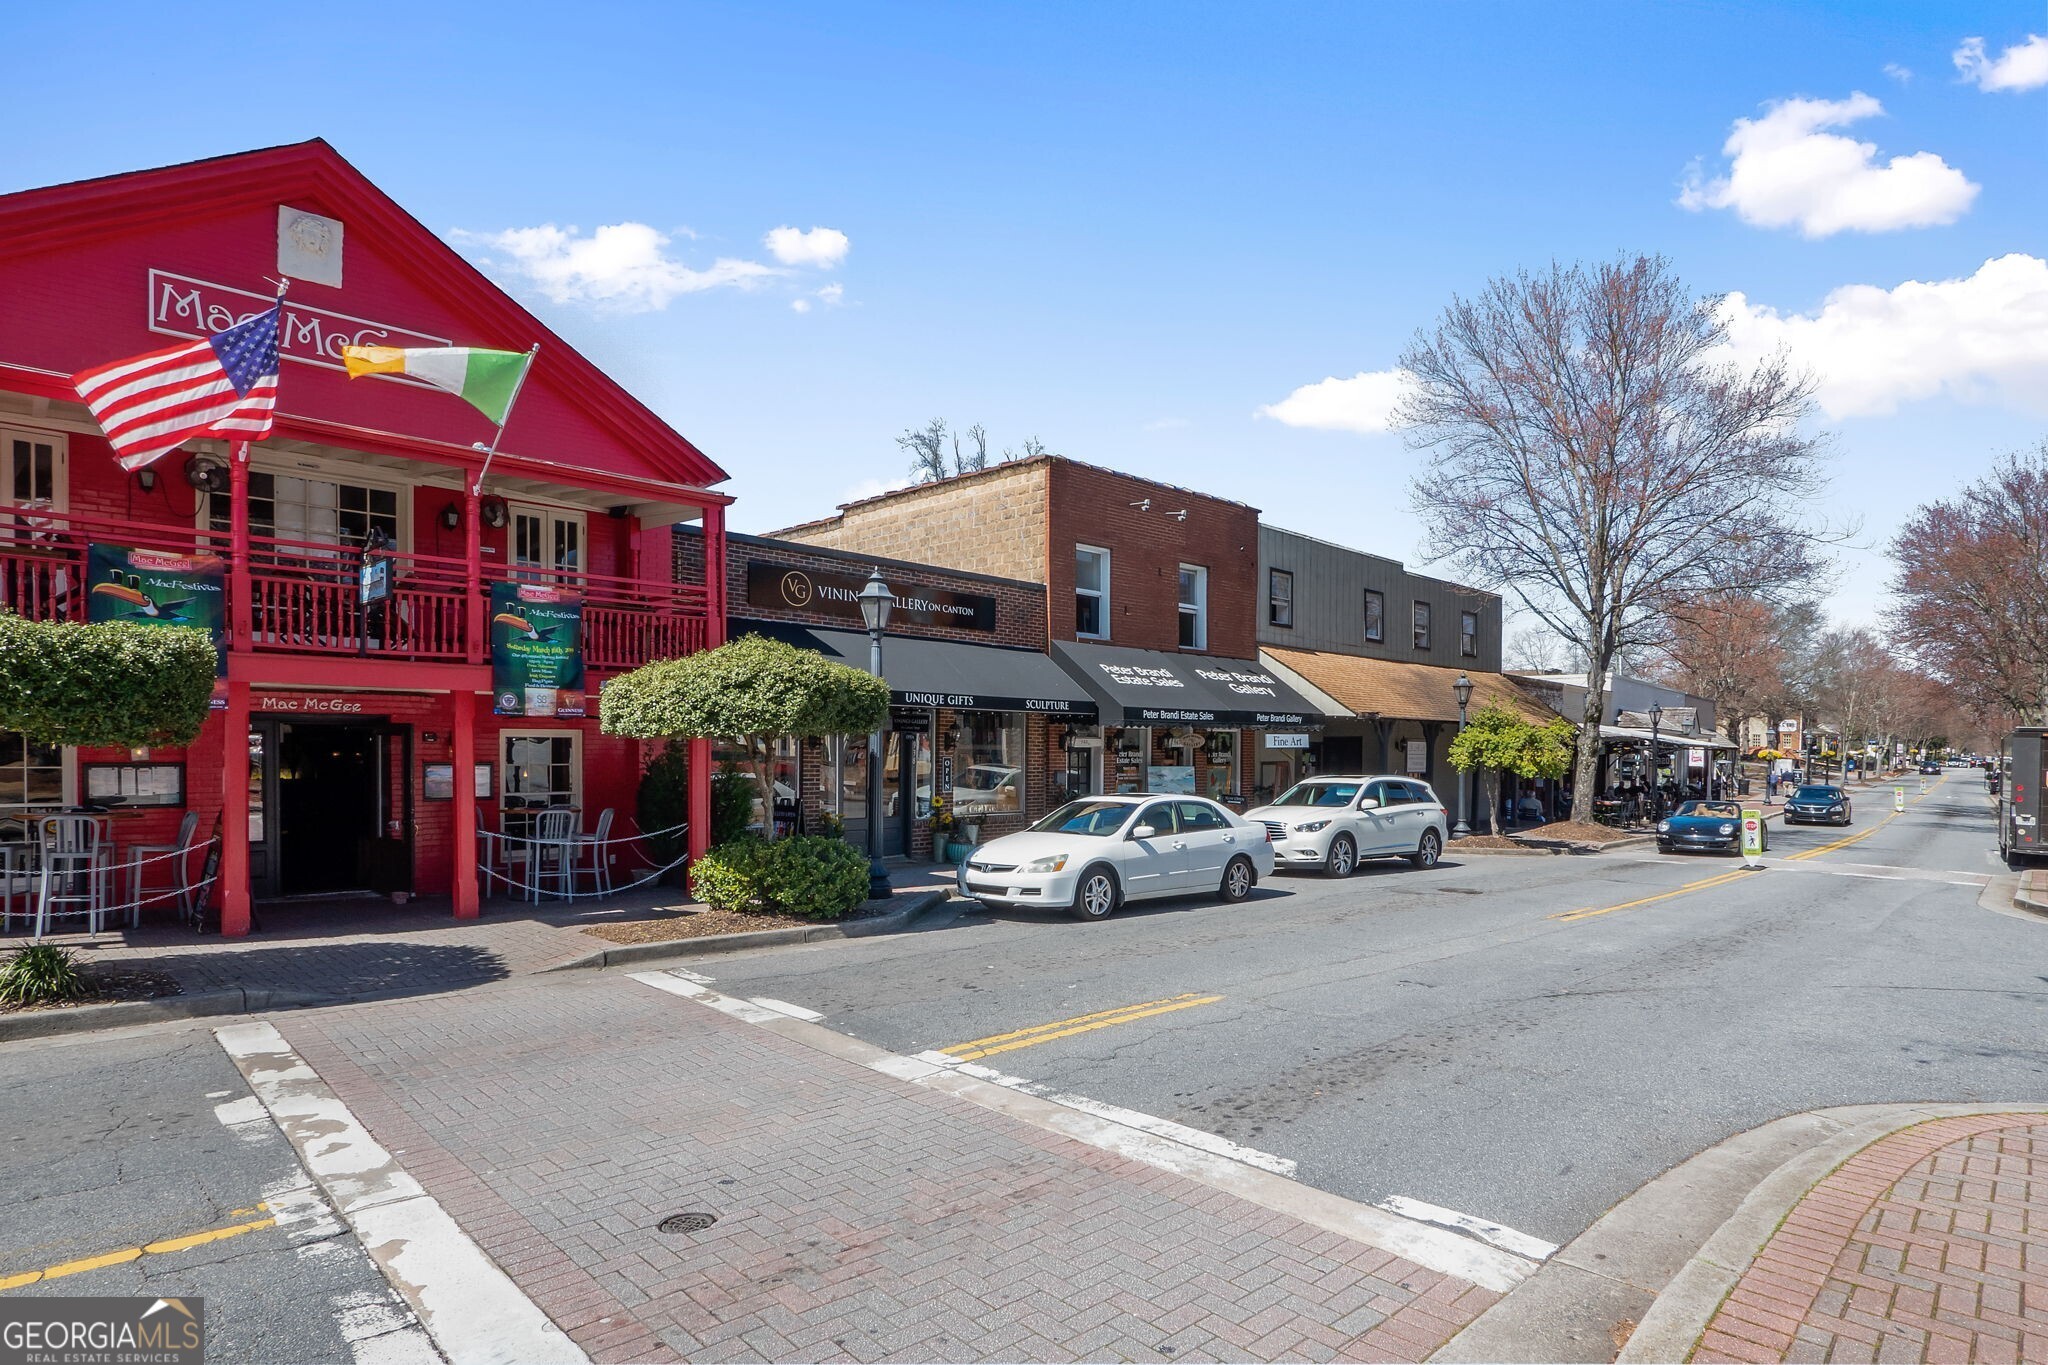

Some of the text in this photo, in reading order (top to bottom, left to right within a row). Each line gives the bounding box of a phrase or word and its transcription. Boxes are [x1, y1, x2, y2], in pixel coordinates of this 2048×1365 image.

[157, 283, 253, 333] Ma
[132, 555, 153, 564] Mac
[145, 578, 221, 592] MacFestivus
[818, 586, 859, 602] VININ
[928, 603, 940, 612] ON
[942, 604, 974, 616] CANTON
[1099, 664, 1174, 678] Peter Brandi
[1195, 669, 1275, 685] Peter Brandi
[1111, 674, 1185, 688] Estate Sales
[1228, 683, 1276, 698] Gallery
[262, 697, 362, 712] Mac McGee
[905, 693, 974, 706] UNIQUE GIFTS
[1025, 699, 1069, 710] SCULPTURE
[1143, 709, 1214, 721] Peter Brandi Estate Sales
[1256, 713, 1302, 724] Peter Brandi Gallery
[1273, 736, 1302, 747] Fine Art
